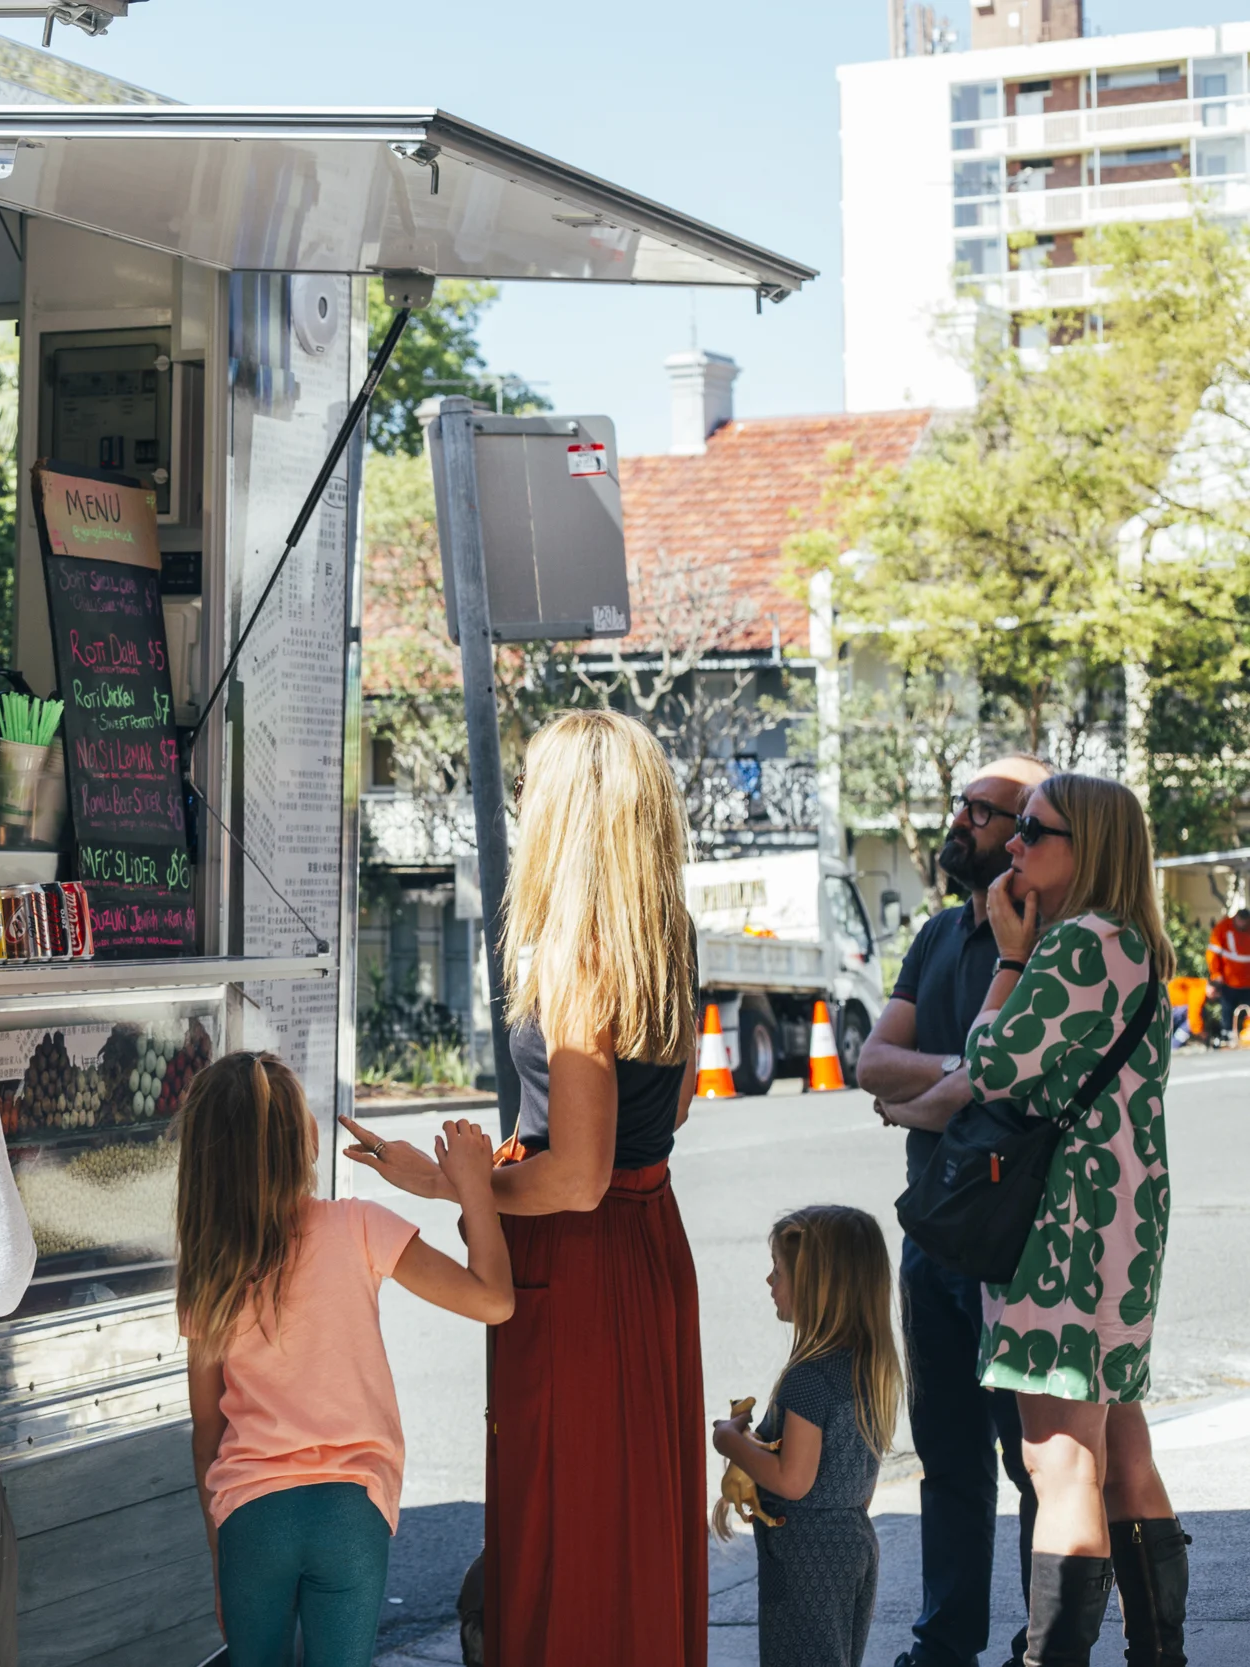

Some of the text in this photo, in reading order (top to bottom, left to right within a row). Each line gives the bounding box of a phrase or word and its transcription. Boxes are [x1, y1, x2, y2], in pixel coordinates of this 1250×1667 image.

[65, 489, 121, 524] MENU
[148, 637, 165, 670] $5
[159, 735, 179, 774] $7
[166, 848, 190, 891] $6
